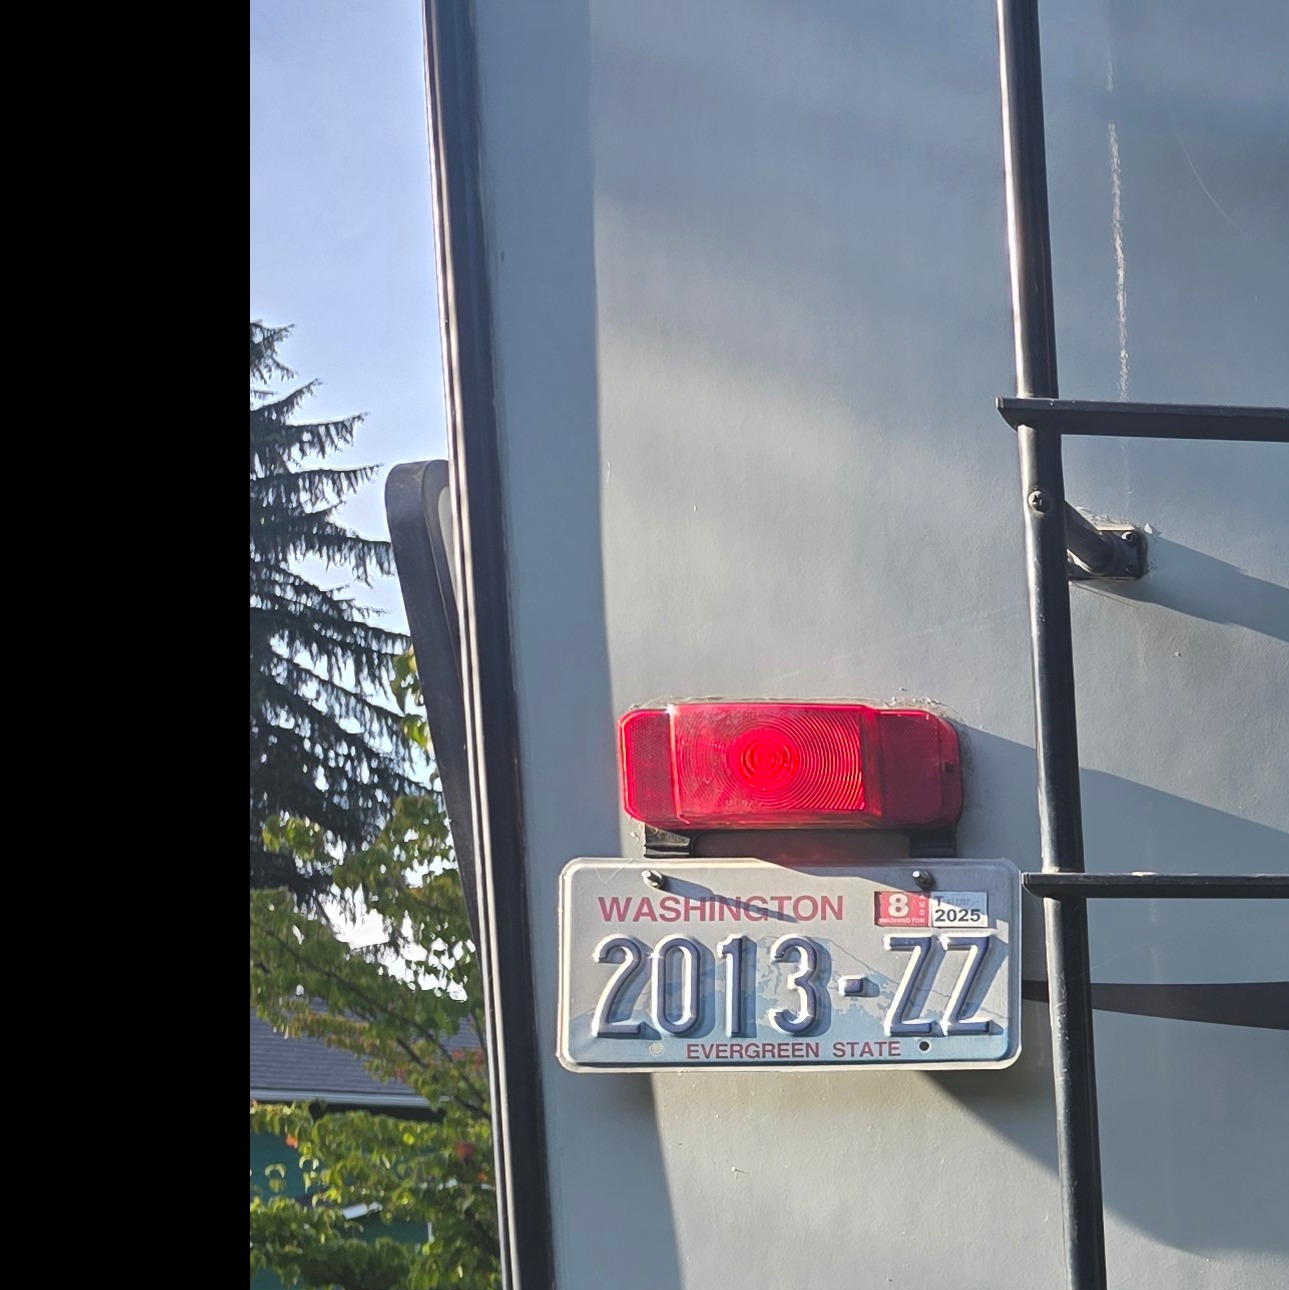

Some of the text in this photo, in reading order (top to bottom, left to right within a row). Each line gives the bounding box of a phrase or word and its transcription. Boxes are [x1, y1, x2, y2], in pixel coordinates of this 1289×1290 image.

[598, 895, 844, 922] WASHINGTON
[888, 893, 909, 917] 8
[934, 909, 981, 923] 2025
[592, 934, 992, 1038] 2013-ZZ
[686, 1041, 901, 1061] EVERGREEN STATE
